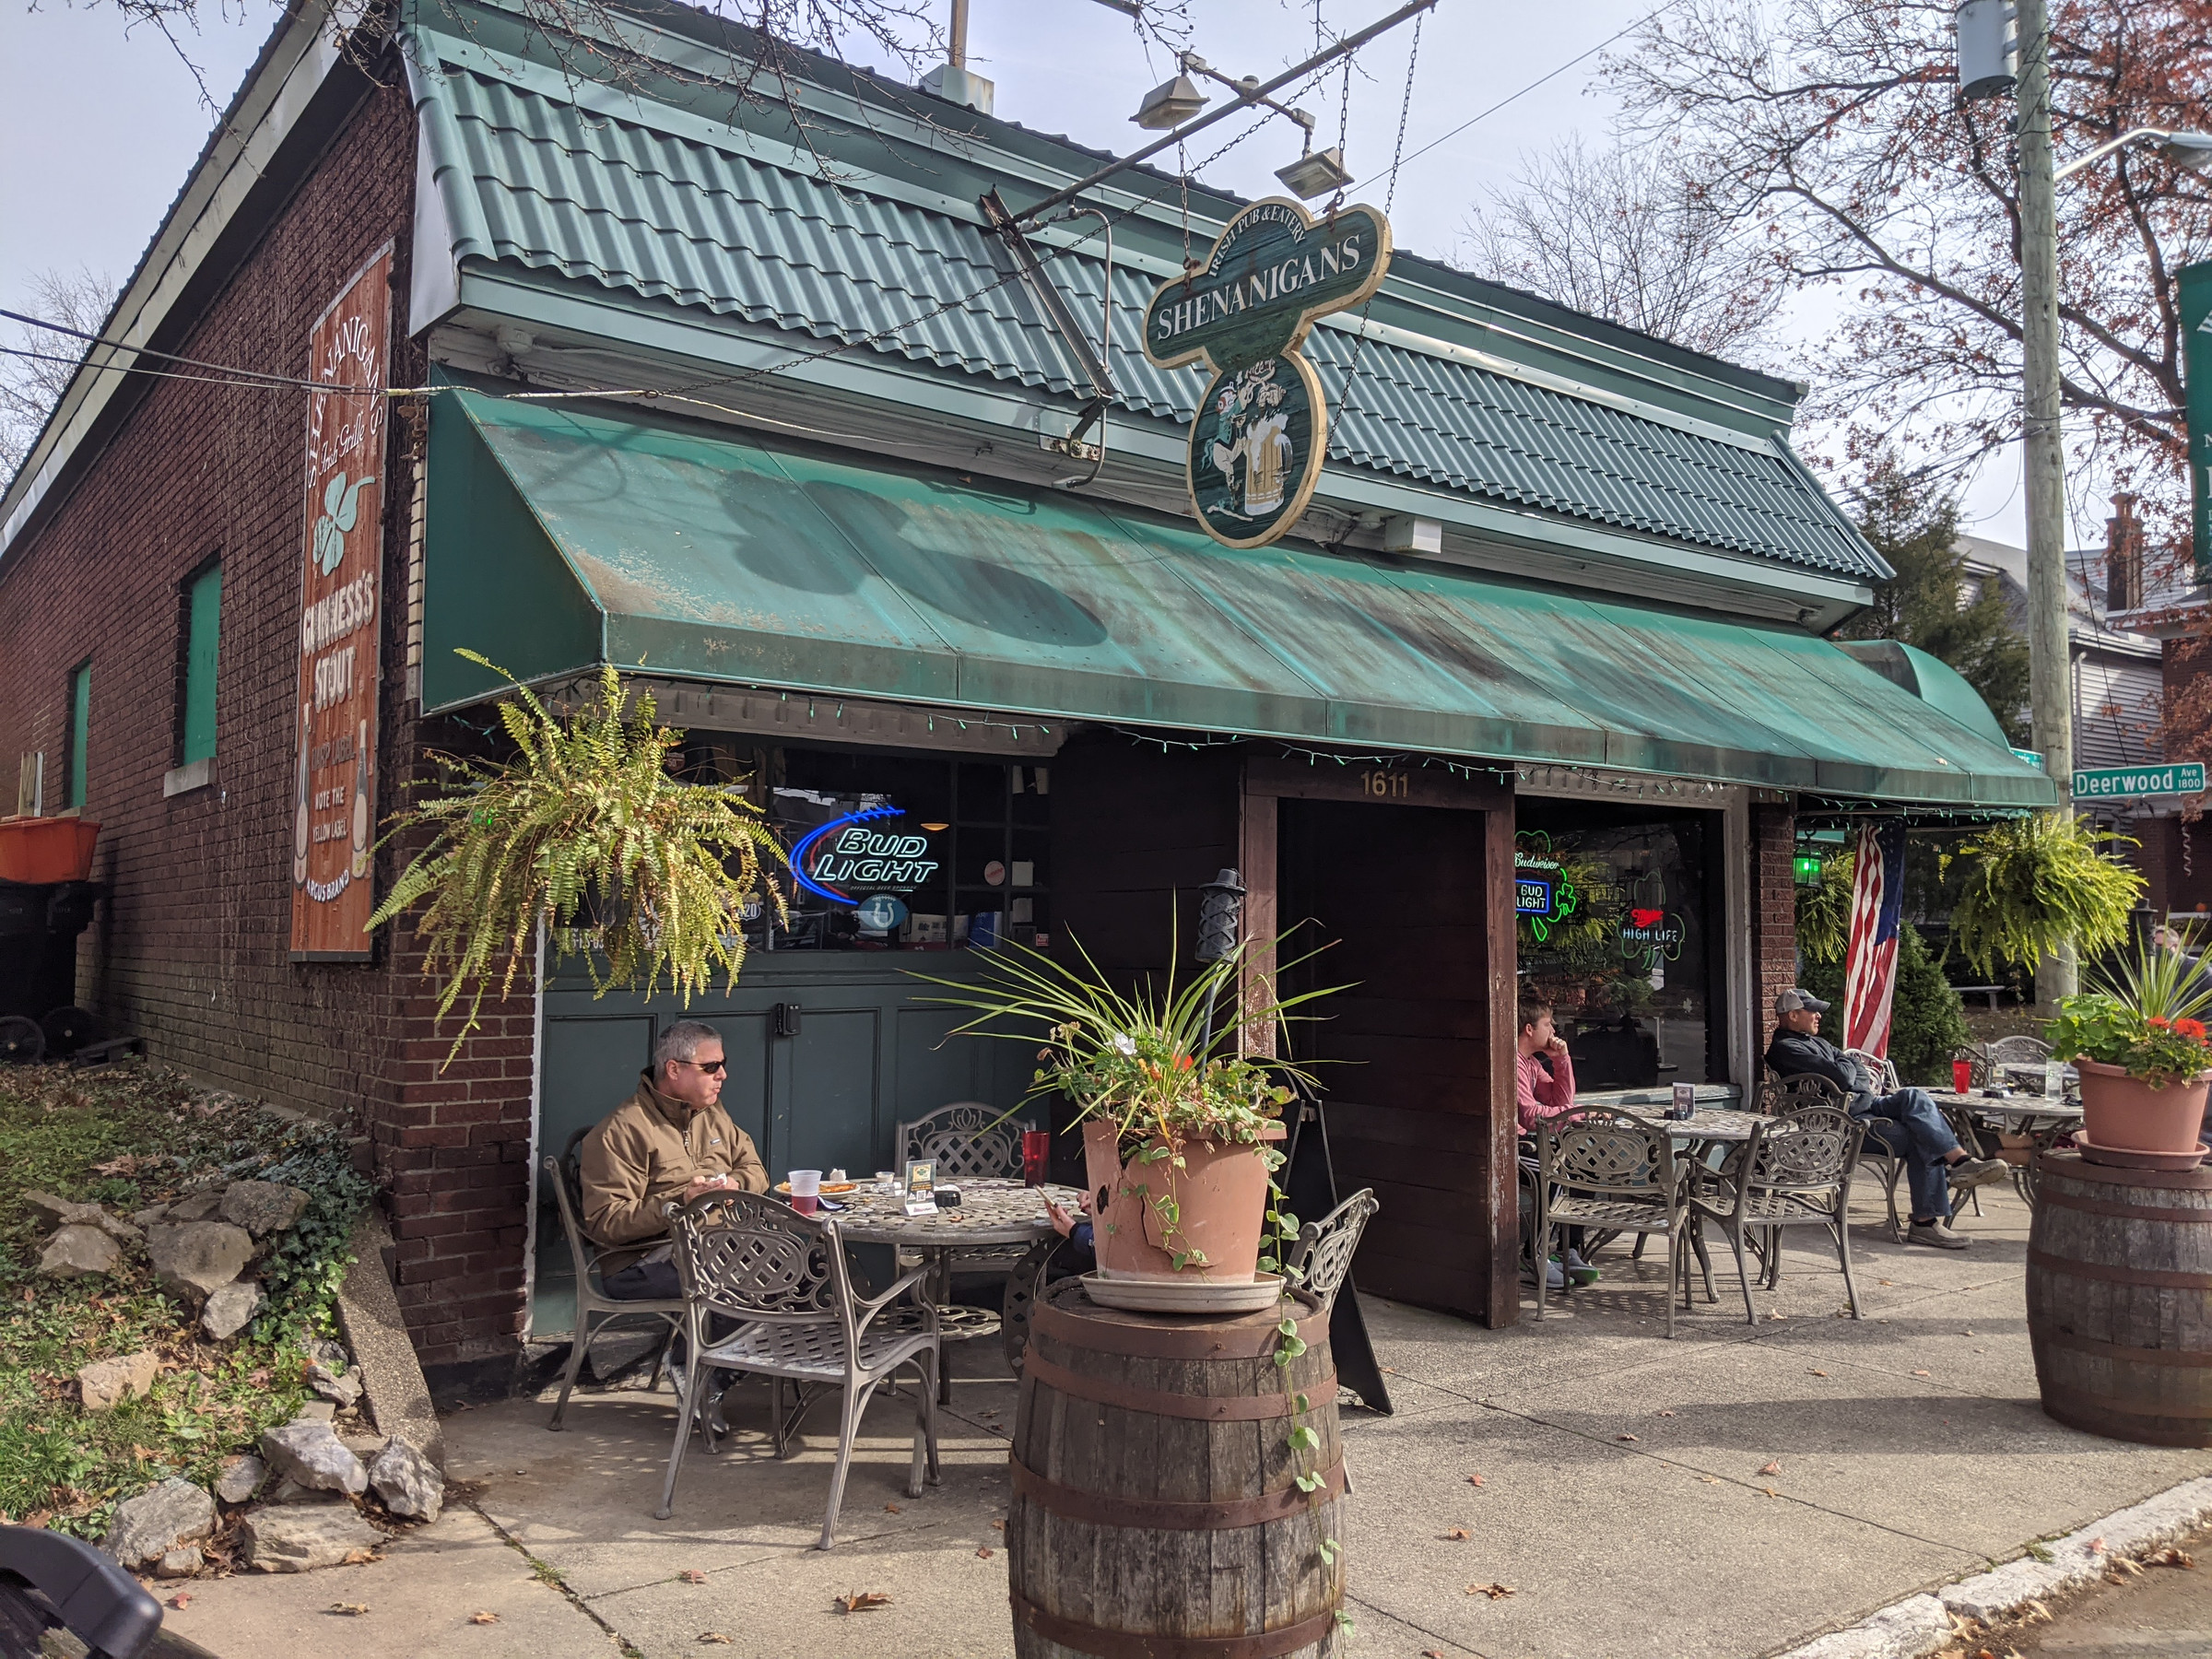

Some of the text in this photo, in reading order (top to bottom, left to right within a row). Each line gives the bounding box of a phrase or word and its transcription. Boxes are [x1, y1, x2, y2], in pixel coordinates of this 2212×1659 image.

[1209, 205, 1306, 277] IRISH PUB & EATERY
[1157, 233, 1361, 341] SHENANIGANS
[308, 315, 384, 489] SHENANIGANS
[319, 434, 340, 477] Irish
[314, 645, 357, 712] STOUT
[1360, 770, 1409, 798] 1611
[2076, 769, 2173, 794] Deerwood
[2178, 779, 2201, 789] 1800
[2181, 768, 2197, 778] Ave
[314, 785, 346, 811] NOTE THE
[312, 817, 348, 842] YELLOW LABEL
[836, 828, 928, 858] BUD
[812, 853, 939, 883] LIGHT
[1514, 852, 1560, 870] Budweiser
[306, 868, 350, 903] ARGUS BRAND
[1521, 885, 1543, 898] BUD
[1516, 896, 1547, 909] LIGHT
[1623, 928, 1677, 943] HIGH LIFE
